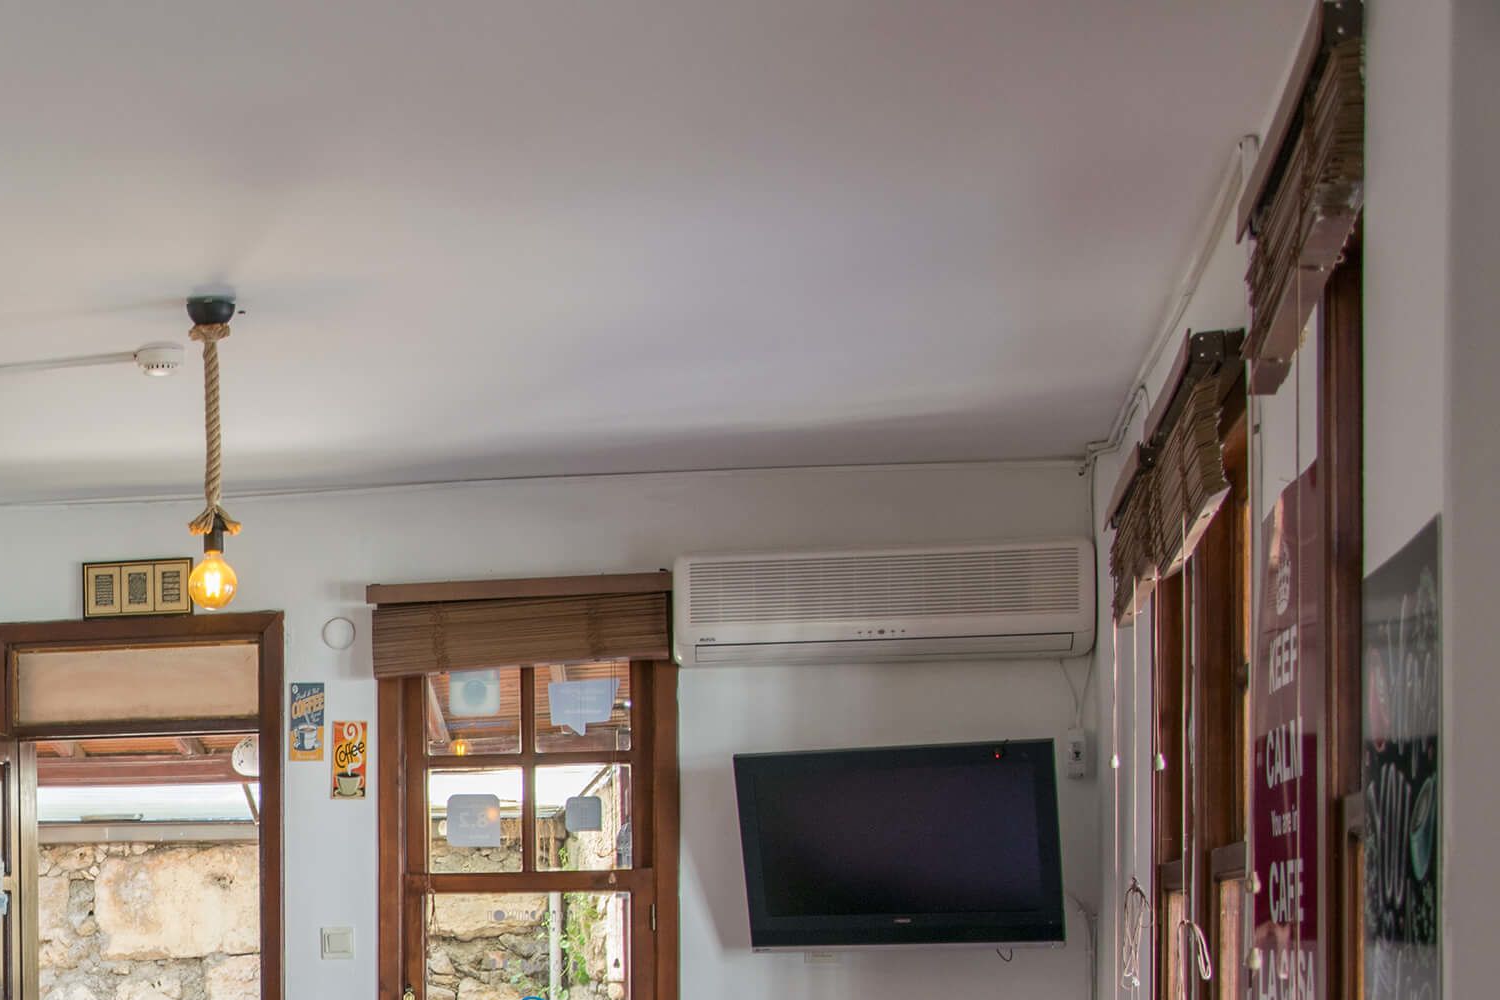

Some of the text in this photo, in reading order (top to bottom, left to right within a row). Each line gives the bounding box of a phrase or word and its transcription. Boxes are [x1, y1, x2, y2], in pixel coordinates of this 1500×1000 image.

[1268, 624, 1298, 695] KEEP
[334, 741, 365, 769] Coffee
[1266, 716, 1304, 789] CALM
[1270, 809, 1282, 838] You
[1269, 858, 1305, 924] CAFE
